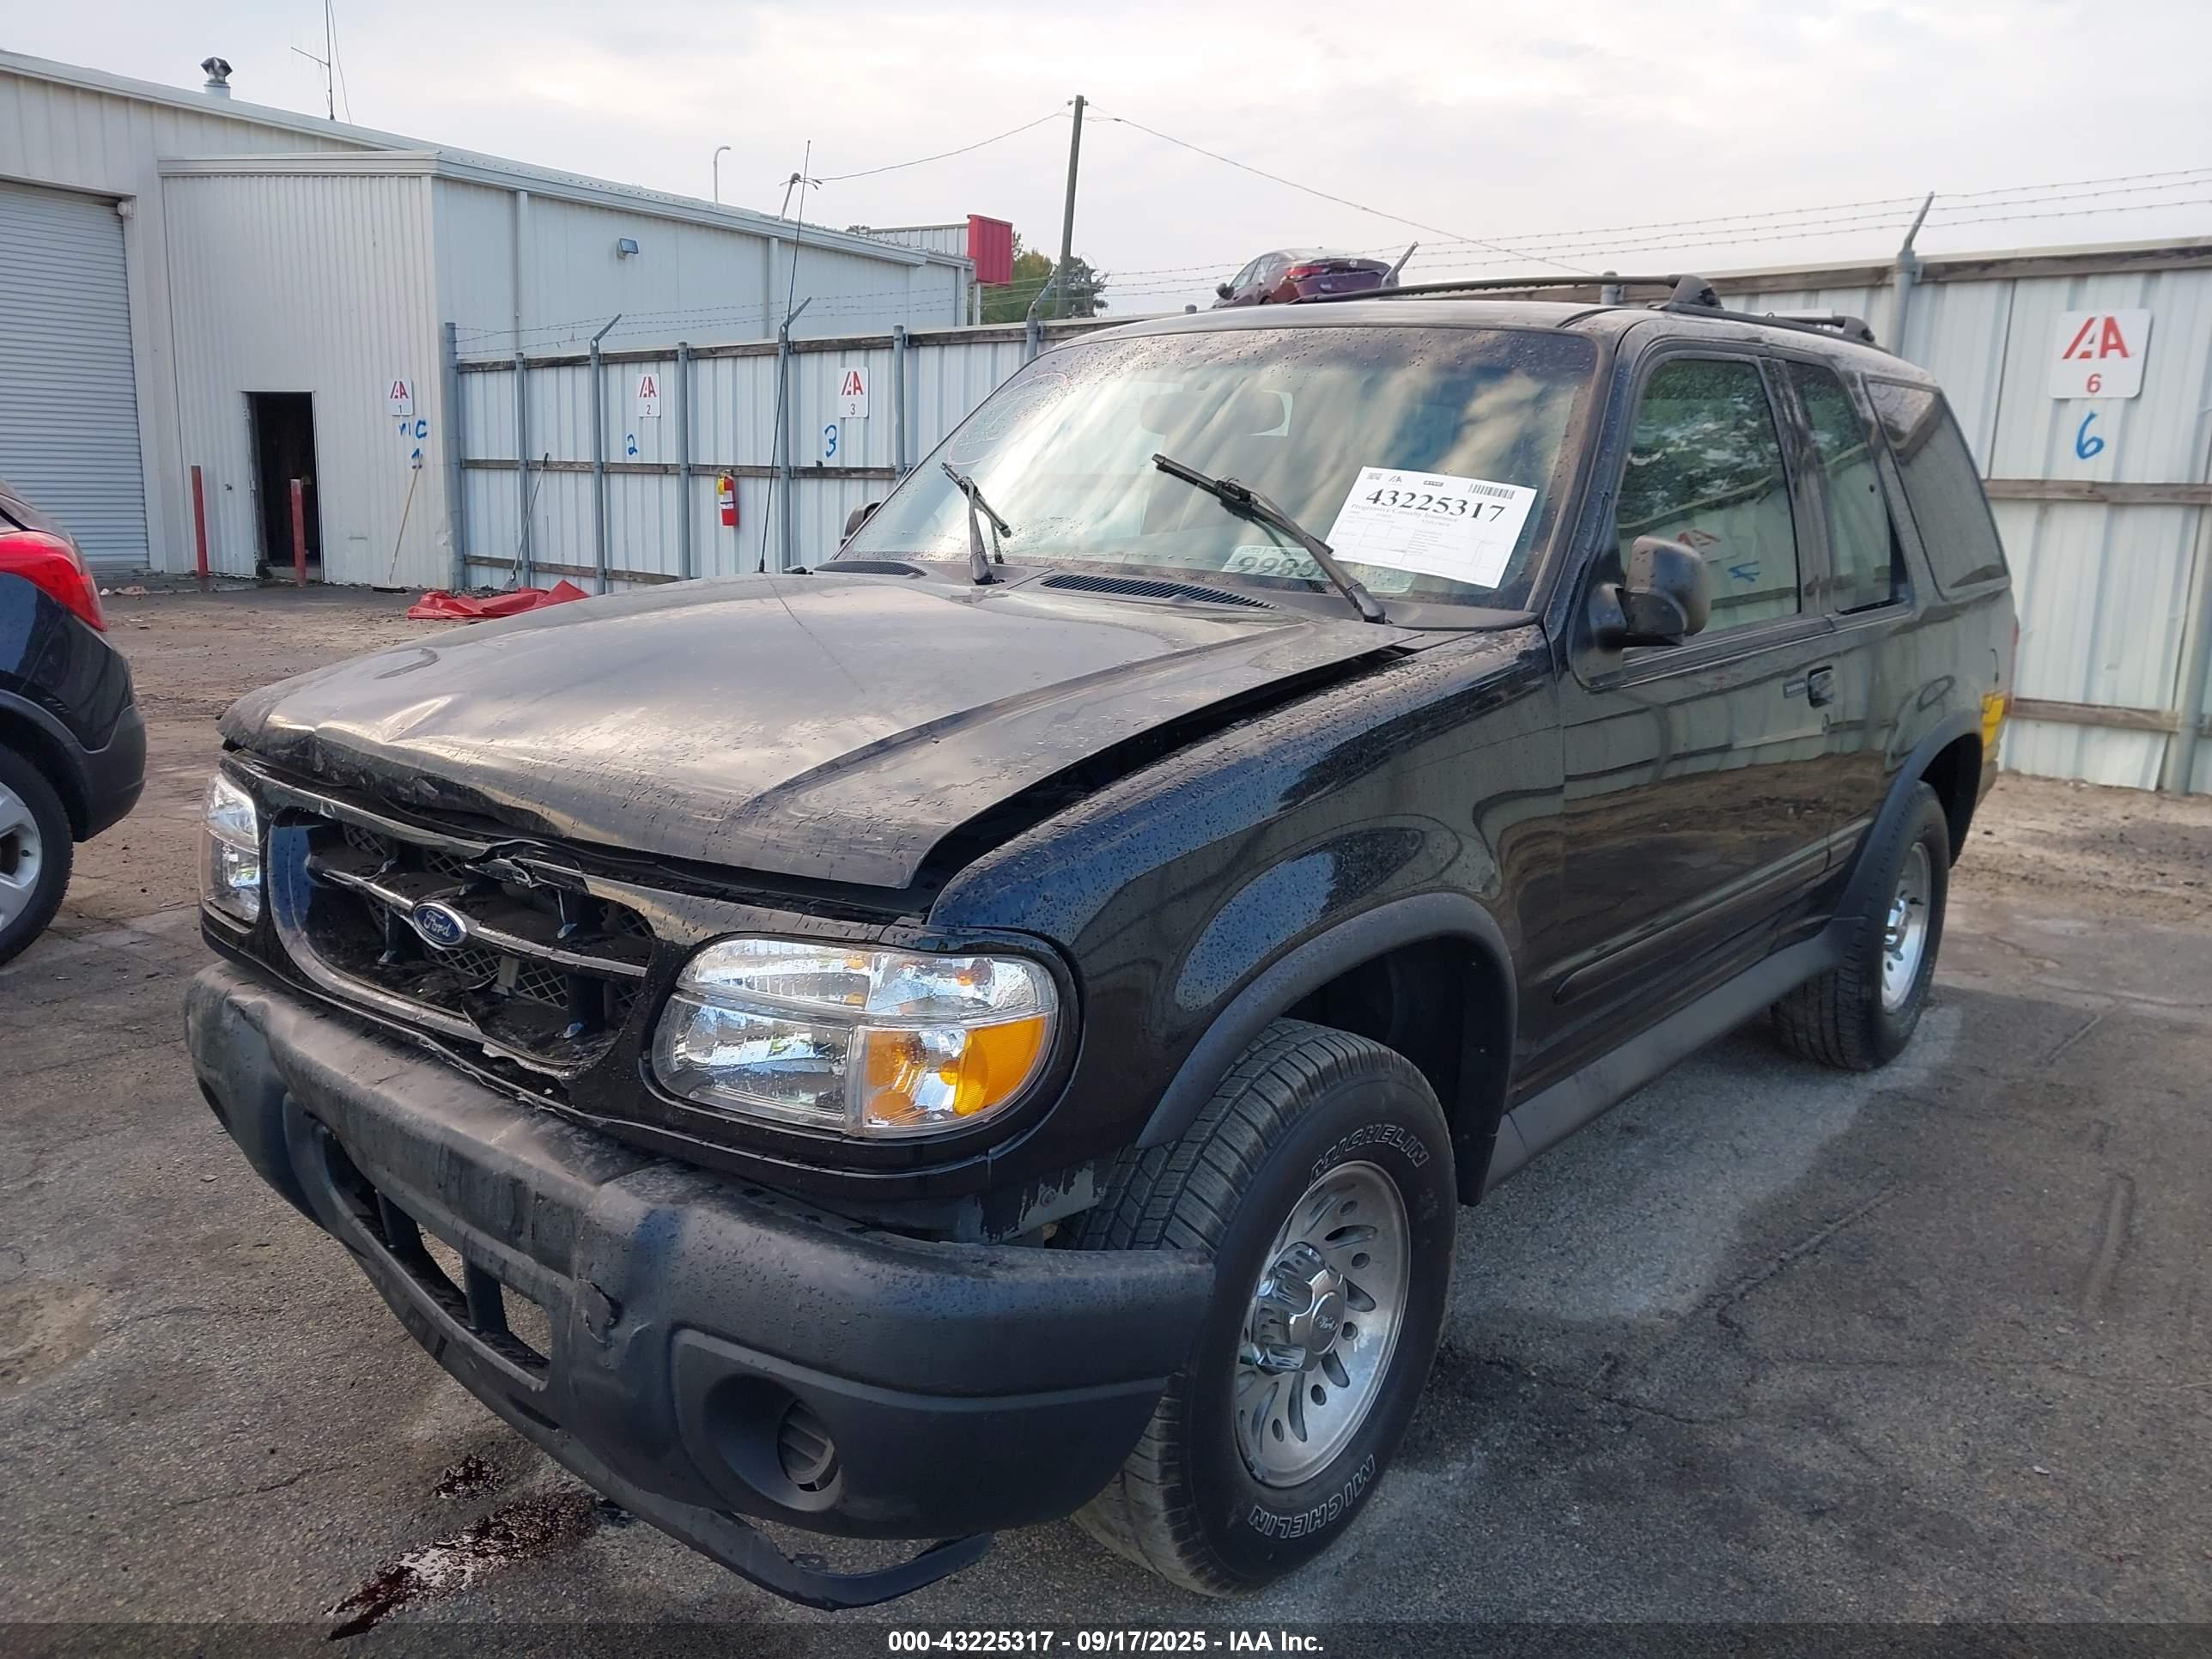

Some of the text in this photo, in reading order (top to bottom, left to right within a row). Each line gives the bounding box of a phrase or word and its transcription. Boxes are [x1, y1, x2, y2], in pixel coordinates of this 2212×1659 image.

[2087, 373, 2102, 393] 6
[647, 404, 652, 415] 2
[850, 404, 856, 415] 3
[627, 434, 638, 455] 2
[824, 424, 838, 458] 3
[2076, 410, 2105, 459] 6
[1365, 488, 1506, 522] 43225317
[423, 910, 453, 938] Ford
[1309, 1123, 1430, 1185] MICHELIN
[1249, 1454, 1376, 1539] MICHELIN
